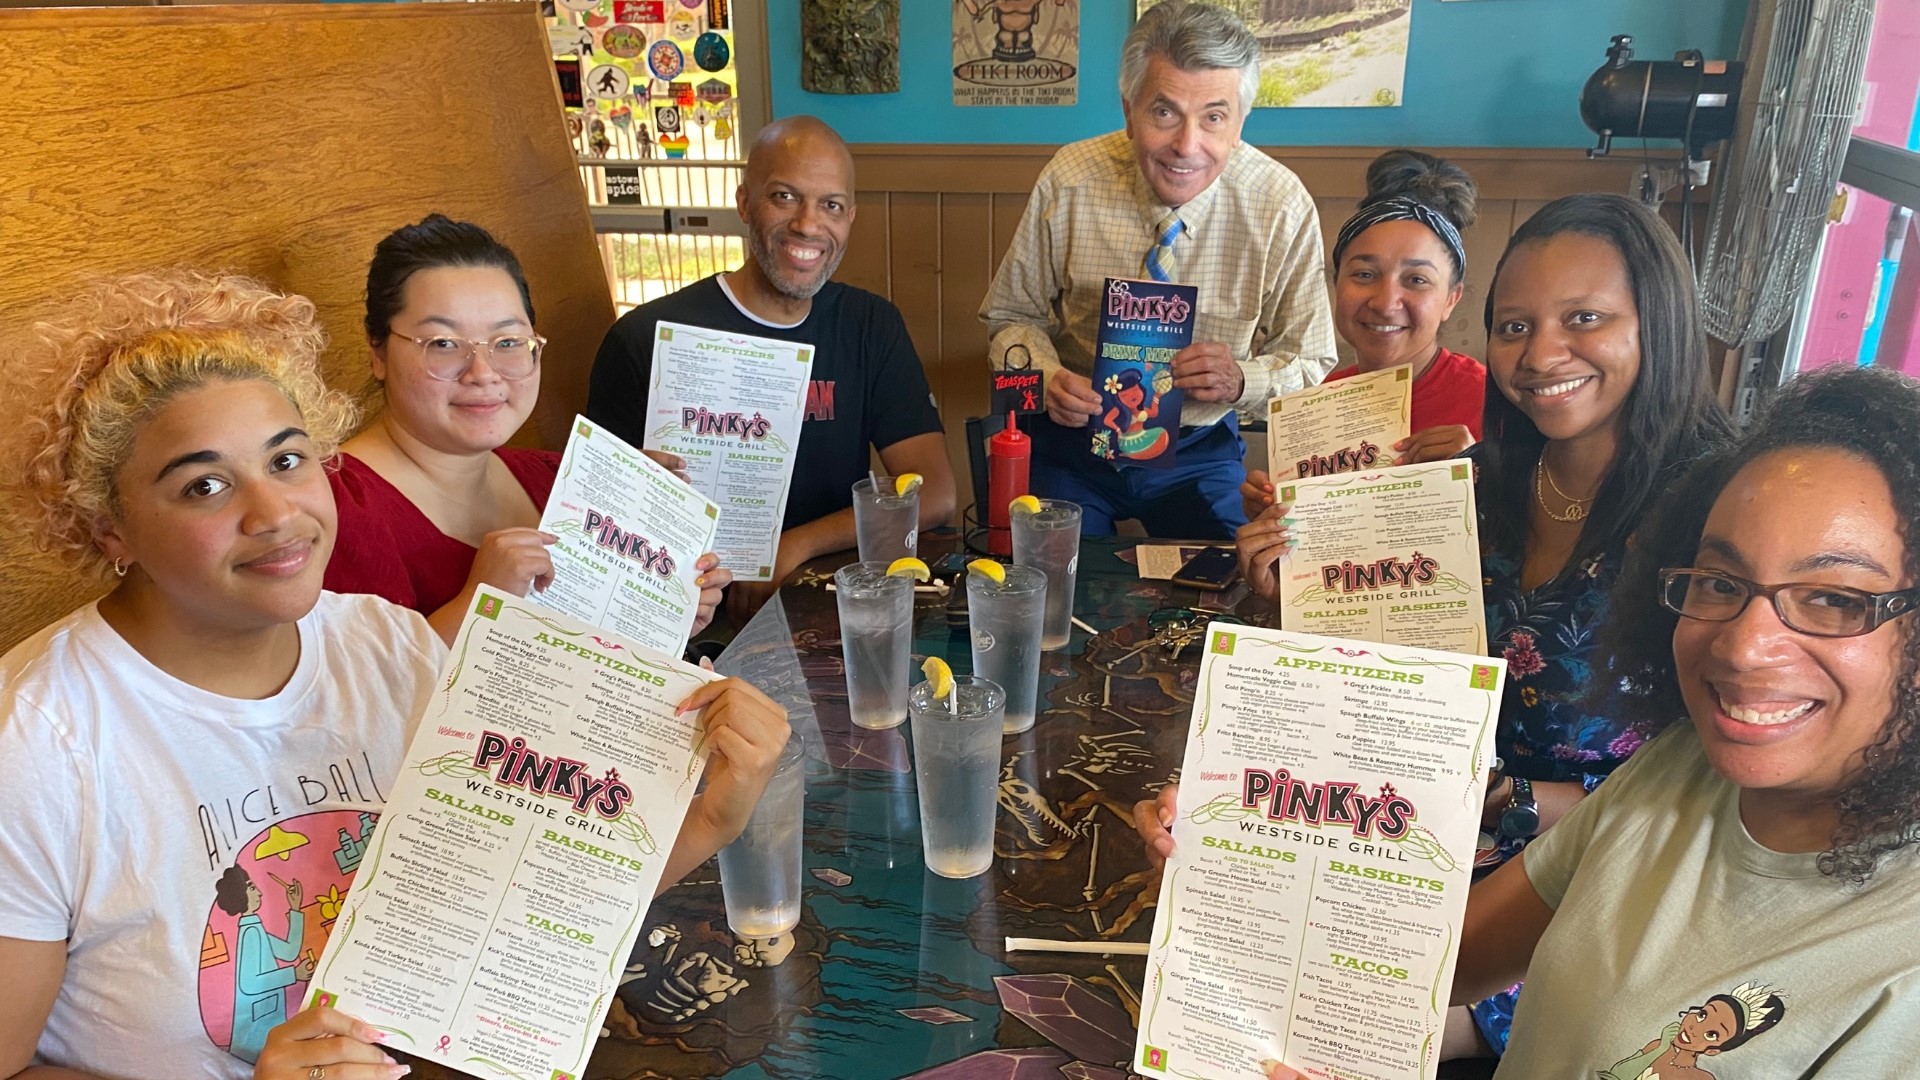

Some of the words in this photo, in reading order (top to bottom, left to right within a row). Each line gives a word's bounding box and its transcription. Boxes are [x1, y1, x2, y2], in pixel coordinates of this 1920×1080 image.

[969, 64, 1008, 80] TIKI
[1016, 64, 1063, 80] ROOM
[954, 88, 975, 96] WHAT
[978, 88, 1010, 96] HAPPENS
[970, 97, 993, 105] STAYS
[607, 184, 640, 197] spice
[1107, 321, 1152, 332] WESTSIDE
[1156, 326, 1183, 334] GRILL
[696, 342, 774, 360] APPETIZERS
[1102, 342, 1142, 361] DRINK
[1144, 347, 1181, 363] MEN
[1301, 384, 1374, 407] APPETIZERS
[660, 445, 712, 457] SALADS
[681, 436, 734, 448] WESTSIDE
[738, 442, 768, 451] GRILL
[728, 452, 784, 464] BASKETS
[612, 450, 686, 501] APPETIZERS
[1324, 480, 1422, 499] APPETIZERS
[728, 496, 766, 505] TACOS
[554, 541, 608, 575] SALADS
[578, 538, 634, 573] WESTSIDE
[638, 570, 669, 594] GRILL
[624, 579, 684, 615] BASKETS
[1326, 593, 1393, 604] WESTSIDE
[1400, 588, 1440, 599] GRILL
[1303, 608, 1368, 619] SALADS
[1390, 600, 1468, 613] BASKETS
[488, 628, 503, 637] Soup
[520, 640, 532, 648] Day
[532, 631, 666, 687] APPETIZERS
[599, 670, 616, 681] Greg's
[617, 677, 635, 688] Pickles
[1226, 671, 1261, 681] Homemade
[1262, 676, 1281, 684] Veggie
[1228, 663, 1243, 671] Soup
[1262, 668, 1274, 676] Day
[1273, 656, 1424, 684] APPETIZERS
[1349, 681, 1369, 689] Greg's
[1370, 684, 1391, 692] Pickles
[1339, 709, 1361, 718] Spaugh
[1386, 716, 1405, 725] Wings
[1432, 724, 1467, 733] marketprice
[437, 725, 466, 739] Welcome
[466, 731, 475, 740] to
[1351, 735, 1375, 743] Puppies
[1199, 771, 1228, 781] Welcome
[1229, 772, 1237, 781] to
[1375, 757, 1406, 768] Rosemary
[1407, 762, 1436, 772] Hummus
[1441, 767, 1453, 775] 9.95
[424, 787, 515, 826] SALADS
[466, 776, 557, 819] WESTSIDE
[565, 815, 618, 840] GRILL
[198, 786, 280, 870] ALICE
[406, 813, 424, 824] Camp
[424, 820, 445, 831] Greene
[445, 827, 464, 838] House
[464, 834, 480, 843] Salad
[541, 828, 642, 871] BASKETS
[1201, 835, 1296, 863] SALADS
[1239, 820, 1338, 848] WESTSIDE
[1348, 841, 1410, 862] GRILL
[1189, 865, 1207, 874] Camp
[1207, 869, 1229, 878] Greene
[1230, 873, 1249, 882] House
[1250, 877, 1266, 885] Salad
[1249, 860, 1274, 870] SALADS
[1328, 860, 1444, 892] BASKETS
[1185, 886, 1208, 895] Spinach
[1209, 891, 1225, 899] Salad
[1229, 895, 1244, 903] 10.95
[1315, 895, 1340, 905] Popcorn
[1341, 901, 1366, 911] Chicken
[1371, 907, 1386, 915] 12.50
[525, 912, 594, 944] TACOS
[1178, 925, 1202, 935] Popcorn
[1203, 931, 1227, 941] Chicken
[1228, 936, 1245, 945] Salad
[1314, 922, 1330, 930] Corn
[1331, 925, 1344, 935] Dog
[1345, 928, 1368, 939] Shrimp
[1372, 934, 1387, 943] 13.95
[1329, 953, 1408, 980] TACOS
[1302, 972, 1315, 980] Fish
[1315, 975, 1332, 984] Tacos
[1337, 980, 1351, 988] 12.95
[1400, 995, 1415, 1003] 14.95
[1299, 992, 1317, 1001] Kick'n
[1318, 997, 1342, 1008] Chicken
[1343, 1003, 1360, 1012] Tacos
[1363, 1008, 1377, 1016] 11.75
[1406, 1018, 1421, 1027] 13.75
